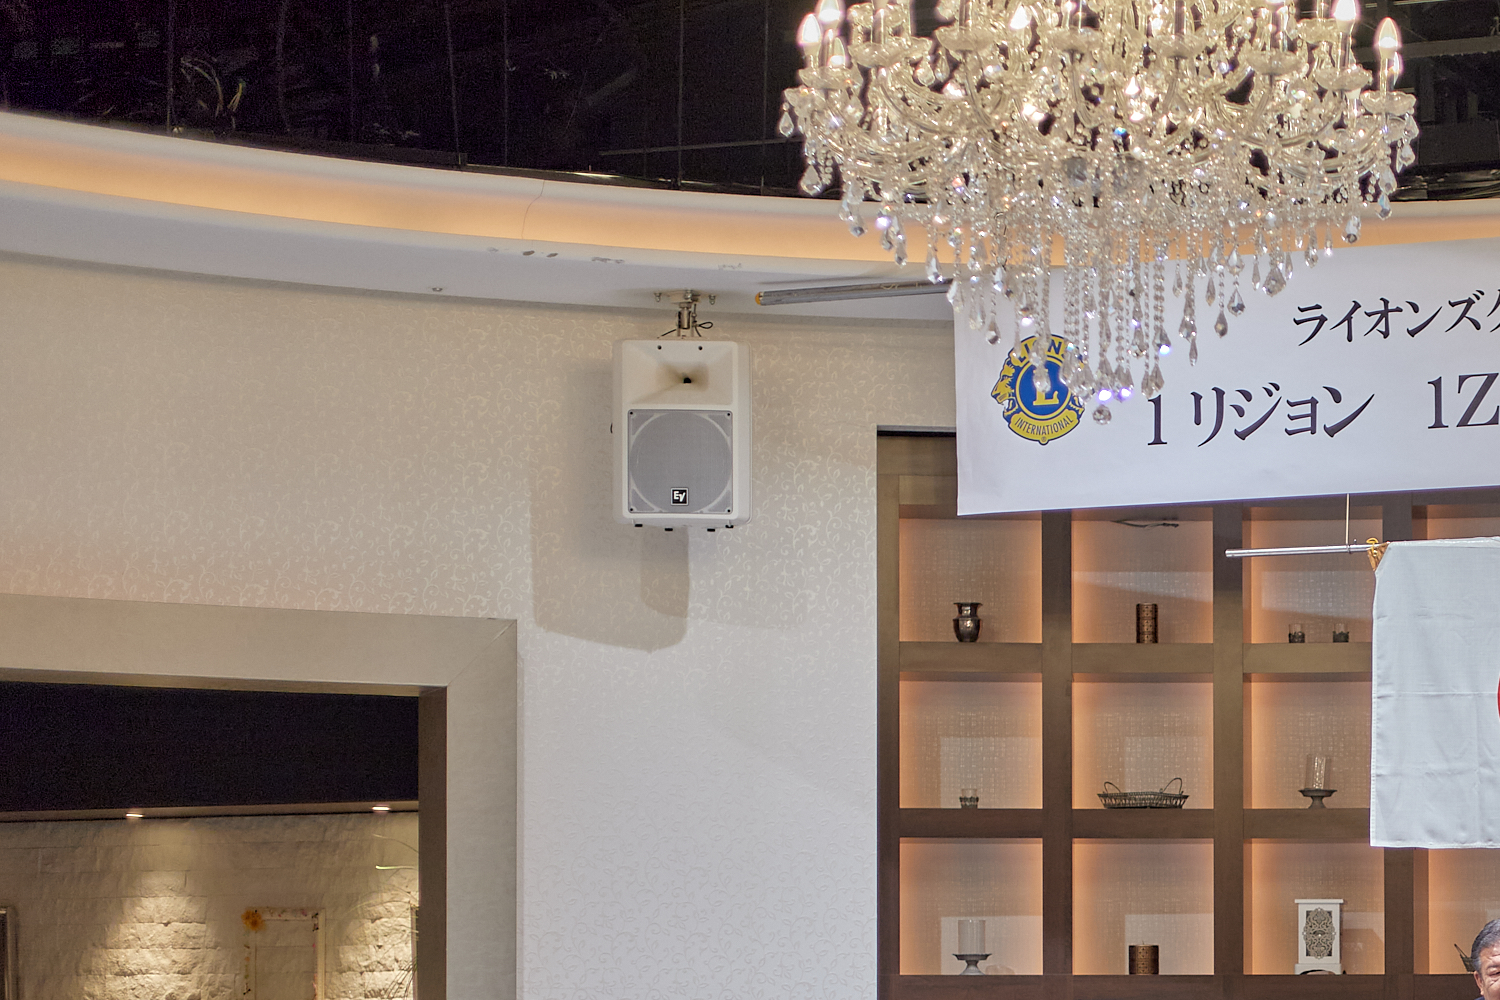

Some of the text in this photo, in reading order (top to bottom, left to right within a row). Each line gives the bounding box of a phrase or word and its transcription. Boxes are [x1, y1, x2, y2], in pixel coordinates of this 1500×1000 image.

[1014, 415, 1074, 436] INTERNATIONAL
[1147, 394, 1168, 446] 1
[1189, 382, 1376, 448] リジョン
